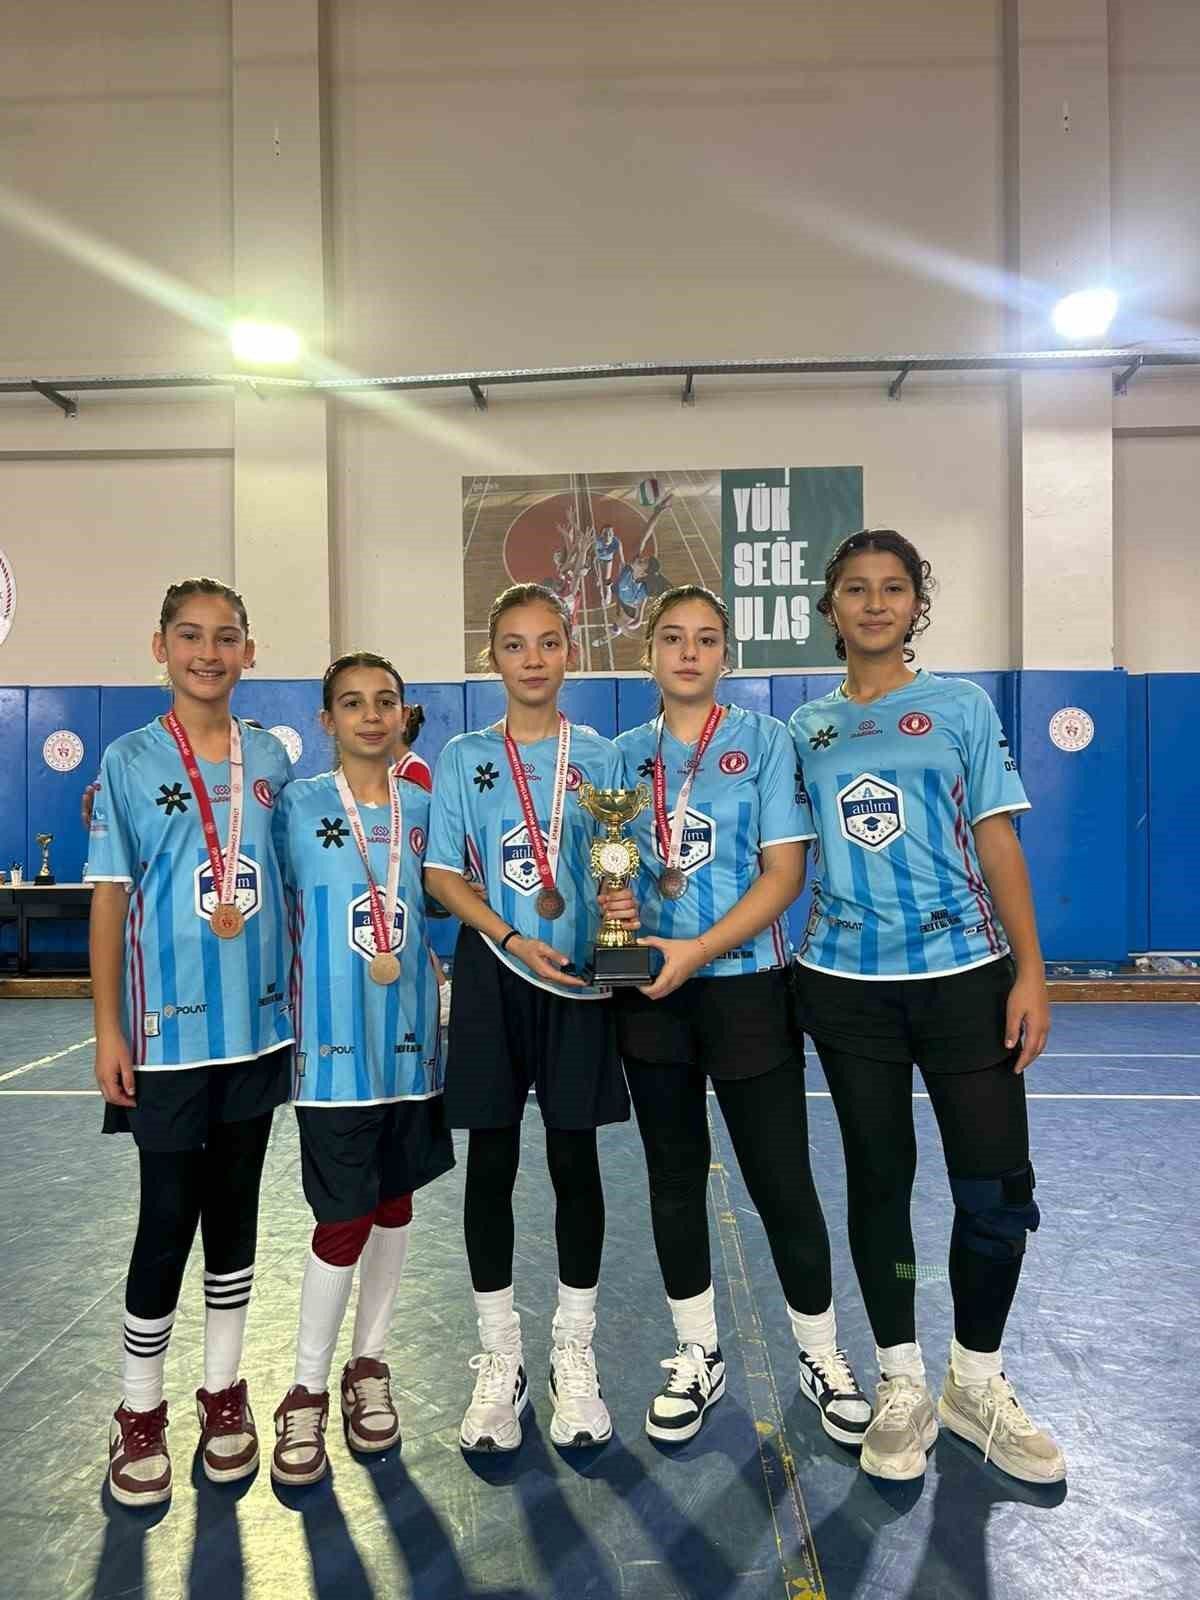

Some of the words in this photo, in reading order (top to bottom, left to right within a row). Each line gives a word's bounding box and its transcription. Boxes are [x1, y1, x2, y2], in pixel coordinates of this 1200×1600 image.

[733, 482, 791, 532] YÜK
[734, 595, 811, 645] ULAŞ
[176, 1003, 208, 1015] POLAT
